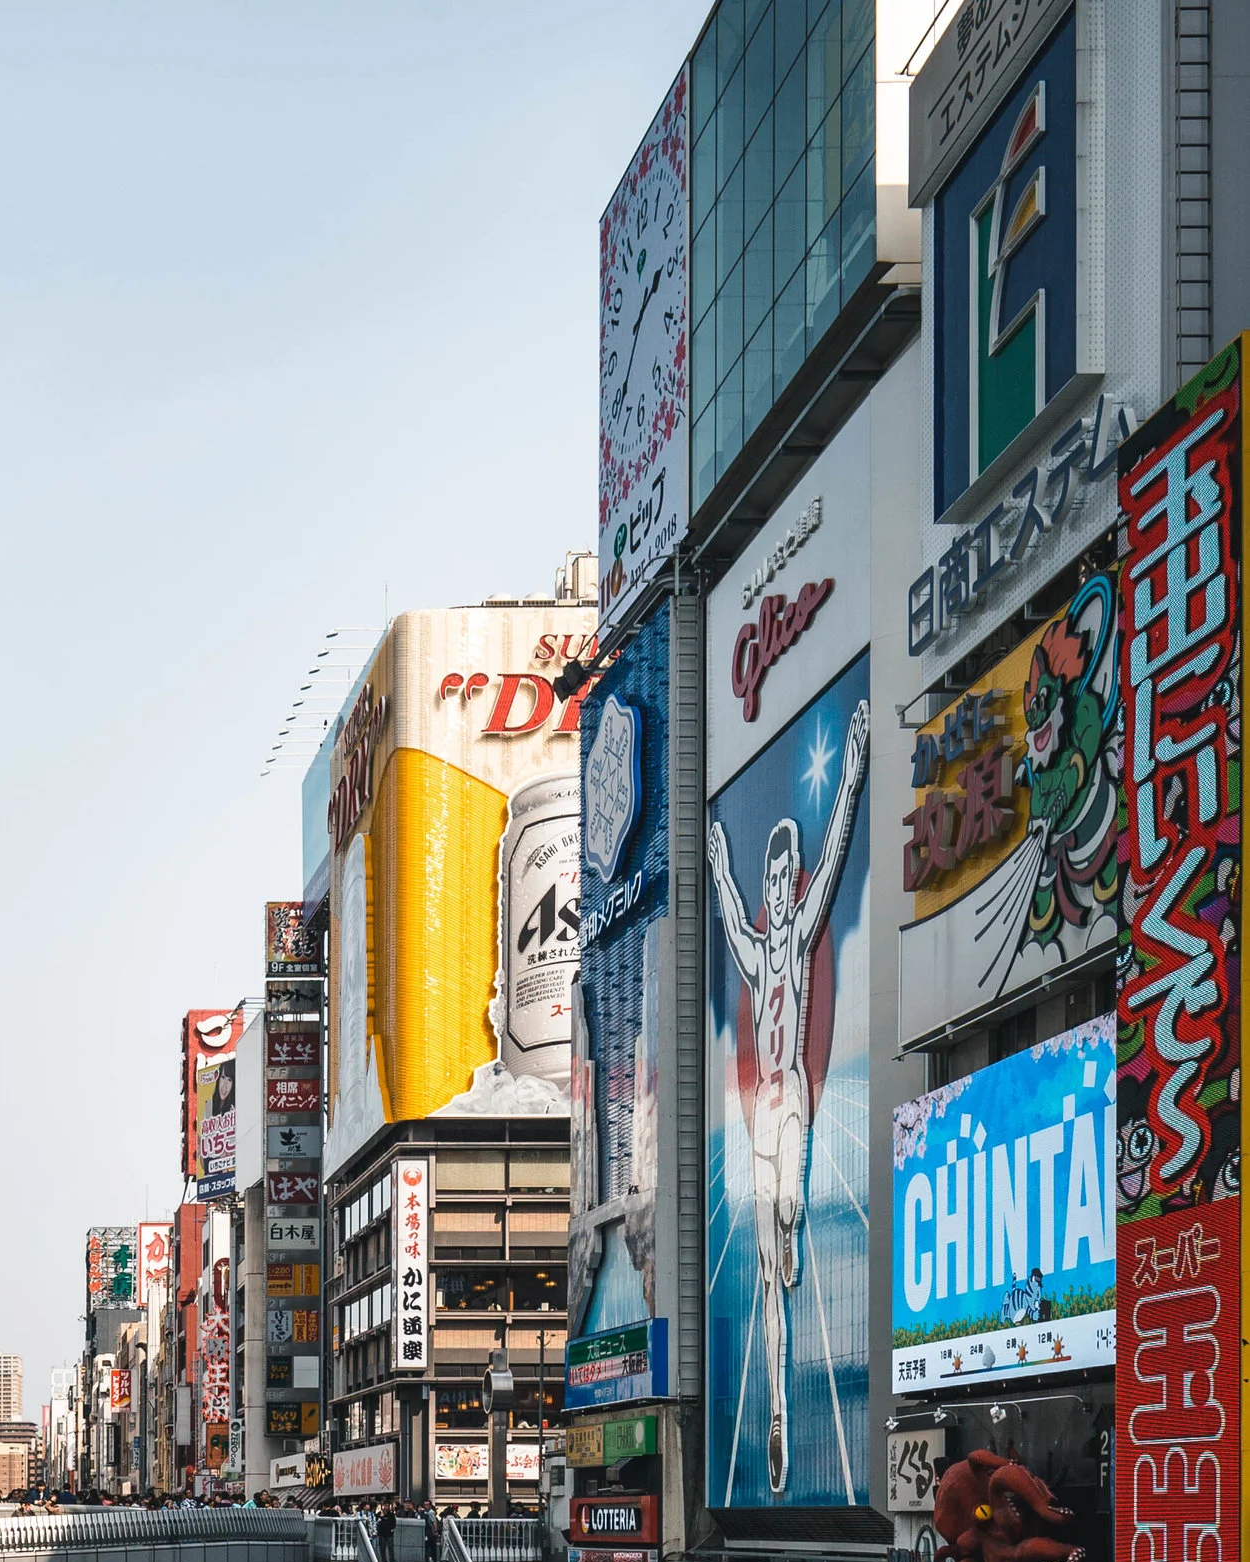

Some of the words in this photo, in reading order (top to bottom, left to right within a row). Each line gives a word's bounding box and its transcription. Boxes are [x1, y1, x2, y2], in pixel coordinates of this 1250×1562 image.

[636, 199, 649, 240] 12
[654, 187, 661, 221] 1
[662, 203, 675, 239] 2
[621, 237, 633, 275] 11
[667, 246, 679, 278] 3
[610, 287, 623, 332] 10
[663, 305, 675, 335] 4
[607, 350, 618, 377] 9
[652, 356, 662, 390] 5
[611, 387, 622, 424] 8
[636, 393, 645, 427] 6
[622, 406, 633, 437] 7
[629, 467, 666, 554] ピップ
[908, 393, 1139, 657] 日商エステム
[655, 513, 677, 556] 2018
[732, 578, 835, 722] Glico
[911, 688, 1002, 788] かぜに
[903, 737, 1010, 892] 改源
[534, 846, 558, 870] ASAHI
[271, 962, 285, 973] 9F
[270, 1042, 316, 1064] 笑笑
[769, 974, 786, 1110] グリコ
[270, 1068, 287, 1078] 7F
[276, 1082, 298, 1094] 相席
[269, 1094, 319, 1109] ダイニング
[269, 1206, 287, 1217] 4F
[404, 1192, 421, 1259] 本場の味
[270, 1223, 316, 1241] 白木屋
[270, 1253, 286, 1262] 3F
[1133, 1223, 1221, 1287] スーパー
[587, 1334, 626, 1361] 大阪ニュース
[1006, 1339, 1017, 1350] 6時
[1038, 1332, 1053, 1344] 12時
[120, 1372, 130, 1396] ツルハ
[898, 1358, 927, 1382] 天気予報
[270, 1422, 299, 1432] ドンキー
[272, 1411, 297, 1421] びっくり
[1100, 1430, 1109, 1487] 2F
[591, 1508, 637, 1531] LOTTERIA
